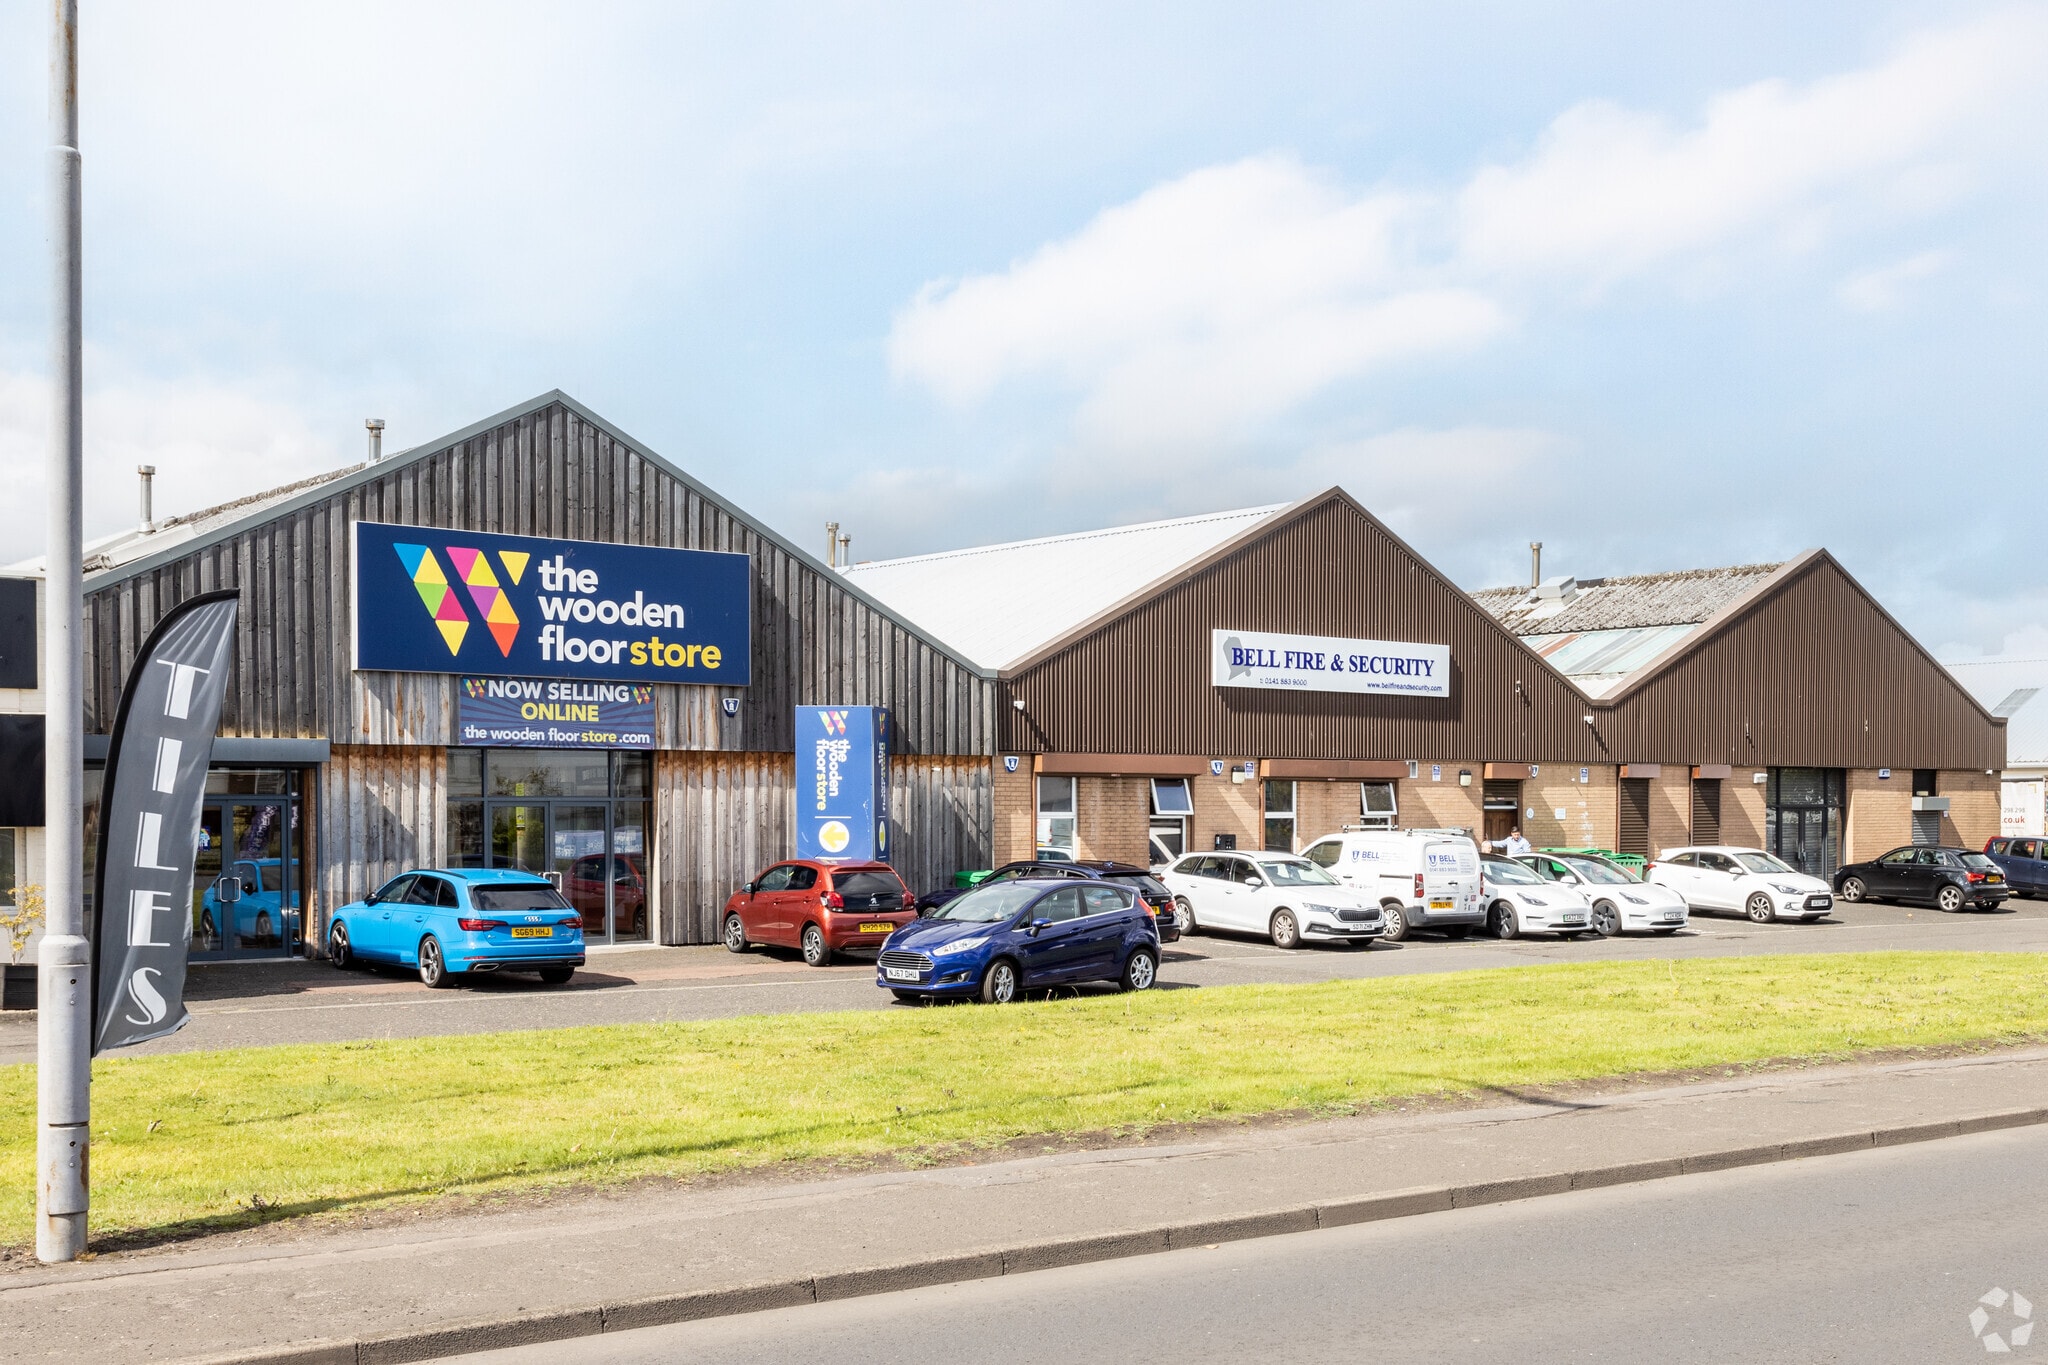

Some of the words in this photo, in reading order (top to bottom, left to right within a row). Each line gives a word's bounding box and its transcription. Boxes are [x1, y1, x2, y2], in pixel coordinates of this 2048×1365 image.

[538, 555, 598, 593] the
[538, 591, 685, 629] wooden
[1231, 647, 1280, 668] BELL
[1285, 650, 1325, 671] FIRE
[1330, 653, 1344, 672] &
[1349, 655, 1434, 677] SECURITY
[488, 680, 543, 700] NOW
[547, 682, 630, 703] SELLING
[1366, 682, 1443, 693] www.bellfireandsecurity.com
[520, 702, 599, 722] ONLINE
[464, 725, 487, 739] the
[489, 727, 545, 741] wooden
[837, 738, 851, 763] the
[828, 739, 843, 797] wooden
[125, 659, 211, 1025] TILES
[1361, 850, 1380, 859] BELL
[1439, 854, 1456, 862] BELL
